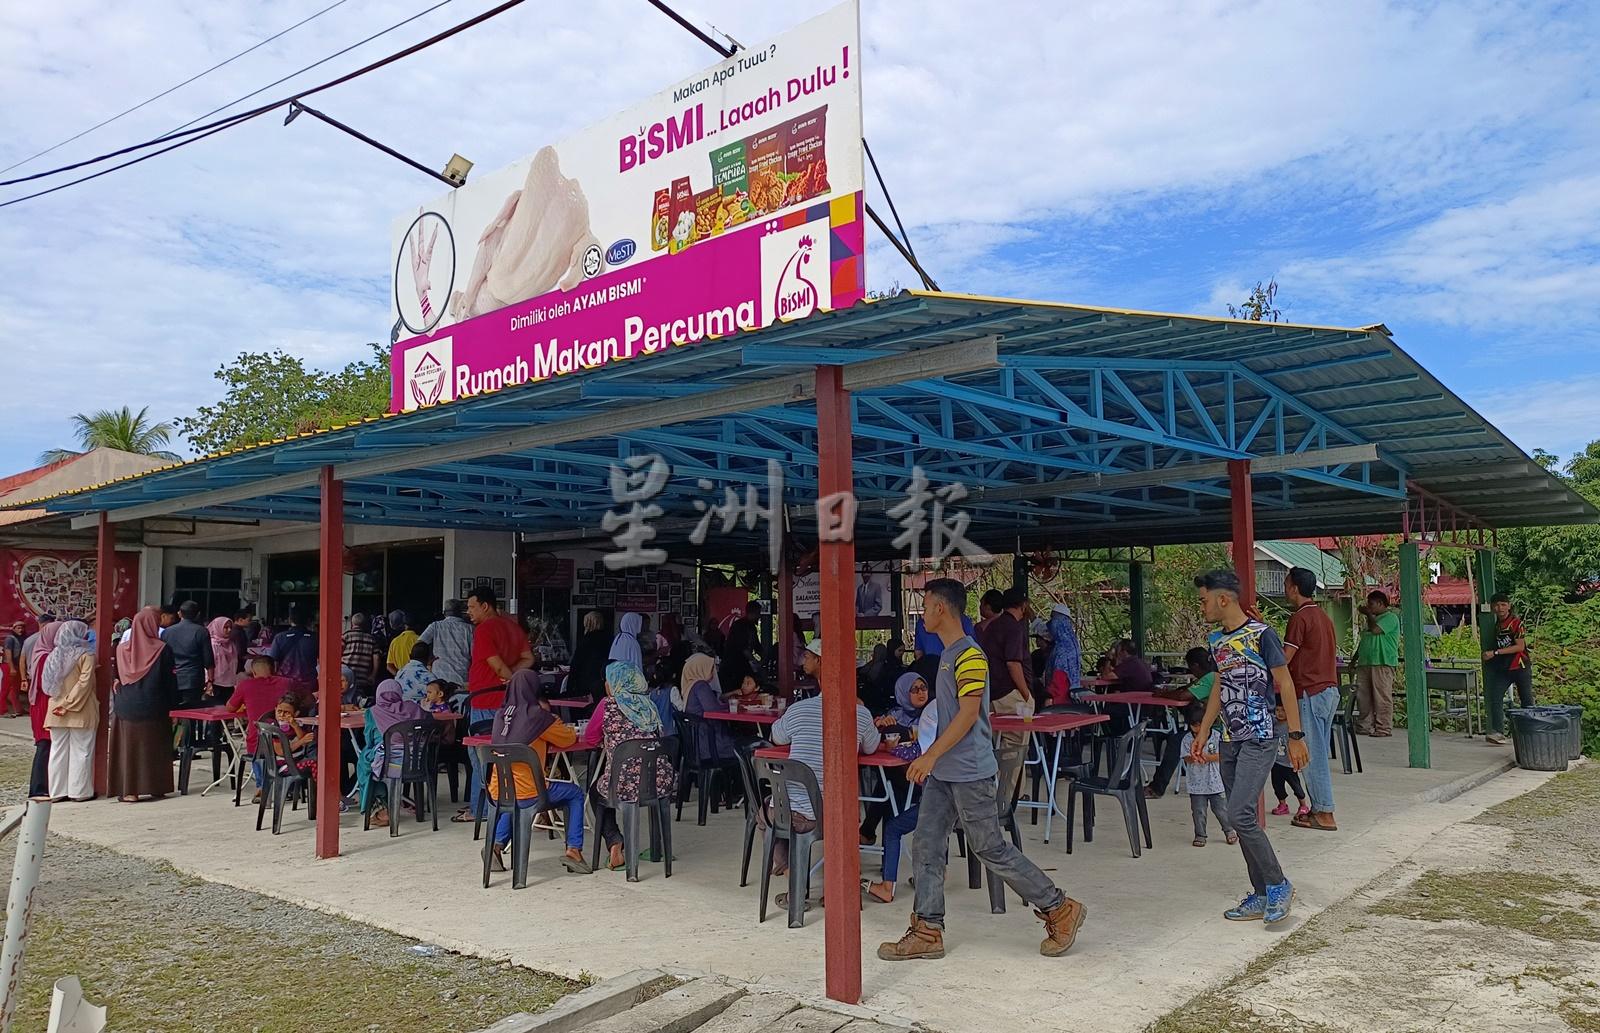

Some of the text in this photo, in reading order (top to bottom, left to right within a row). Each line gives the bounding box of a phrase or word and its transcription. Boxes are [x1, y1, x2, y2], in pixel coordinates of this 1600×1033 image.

[673, 77, 709, 104] Makan
[712, 64, 735, 86] Apa
[737, 51, 767, 74] Tuuu
[720, 87, 781, 131] Laaah
[787, 65, 837, 103] Dulu
[714, 164, 746, 185] TEMPURA
[607, 242, 634, 263] MeSTI
[510, 309, 547, 332] Dimiliki
[548, 301, 571, 320] oleh
[572, 290, 607, 313] AYAM
[455, 300, 755, 396] Rumah Makan Percuma
